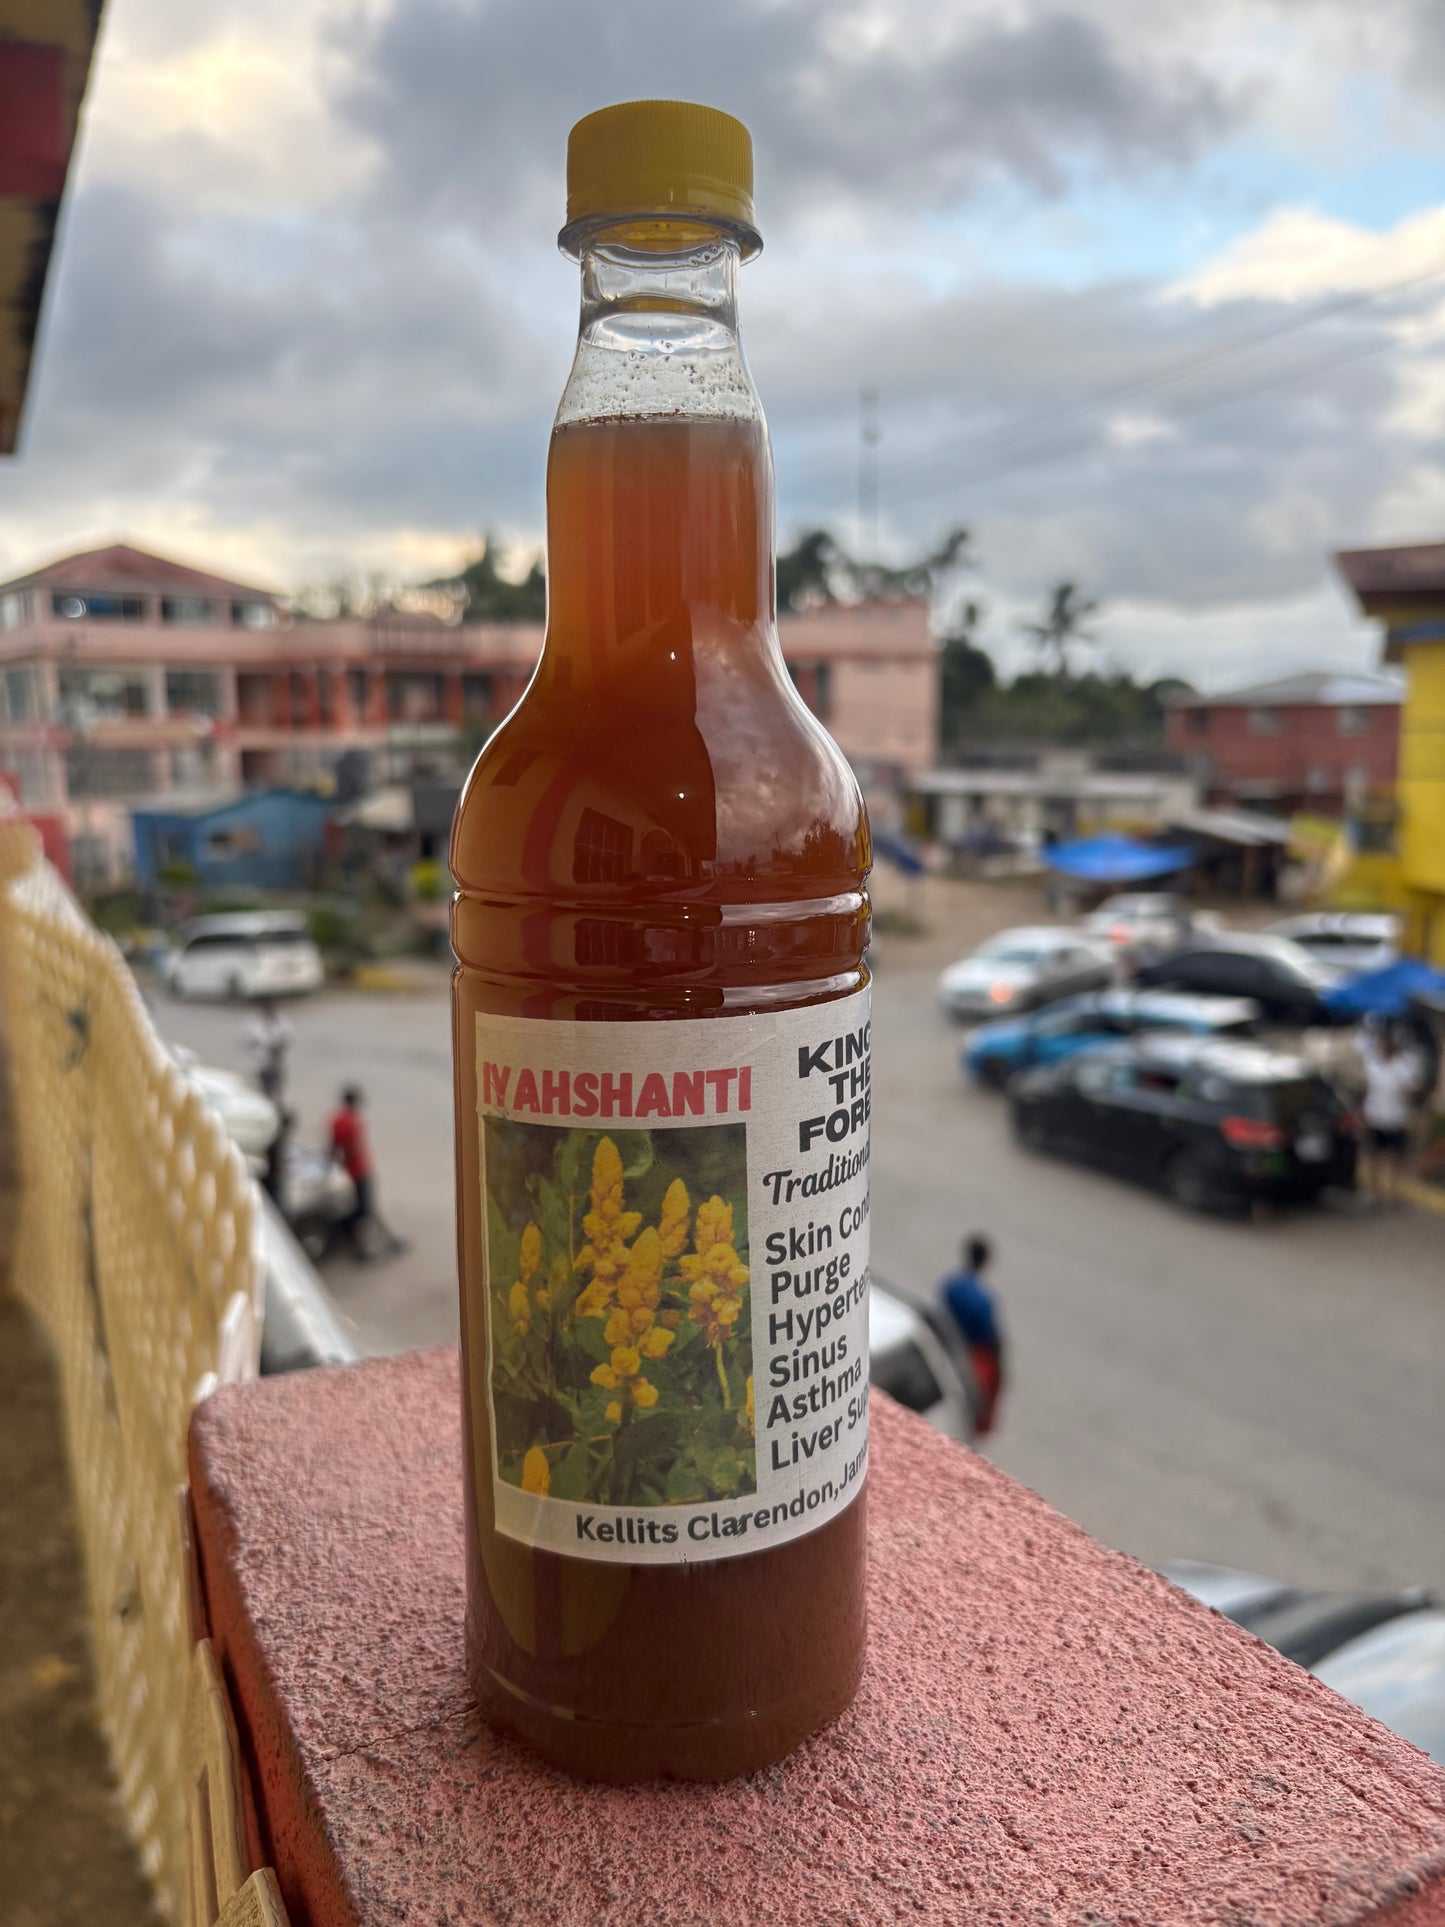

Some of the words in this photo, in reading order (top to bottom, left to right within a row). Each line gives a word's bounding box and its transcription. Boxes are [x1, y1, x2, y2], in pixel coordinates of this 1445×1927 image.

[483, 1061, 752, 1118] IYAHSHANTI
[828, 1055, 871, 1105] THE
[765, 1221, 832, 1266] Skin
[771, 1252, 850, 1305] Purge
[769, 1334, 848, 1388] Sinus
[766, 1357, 862, 1429] Asthma
[771, 1416, 843, 1471] Liver
[576, 1514, 678, 1544] Kellits
